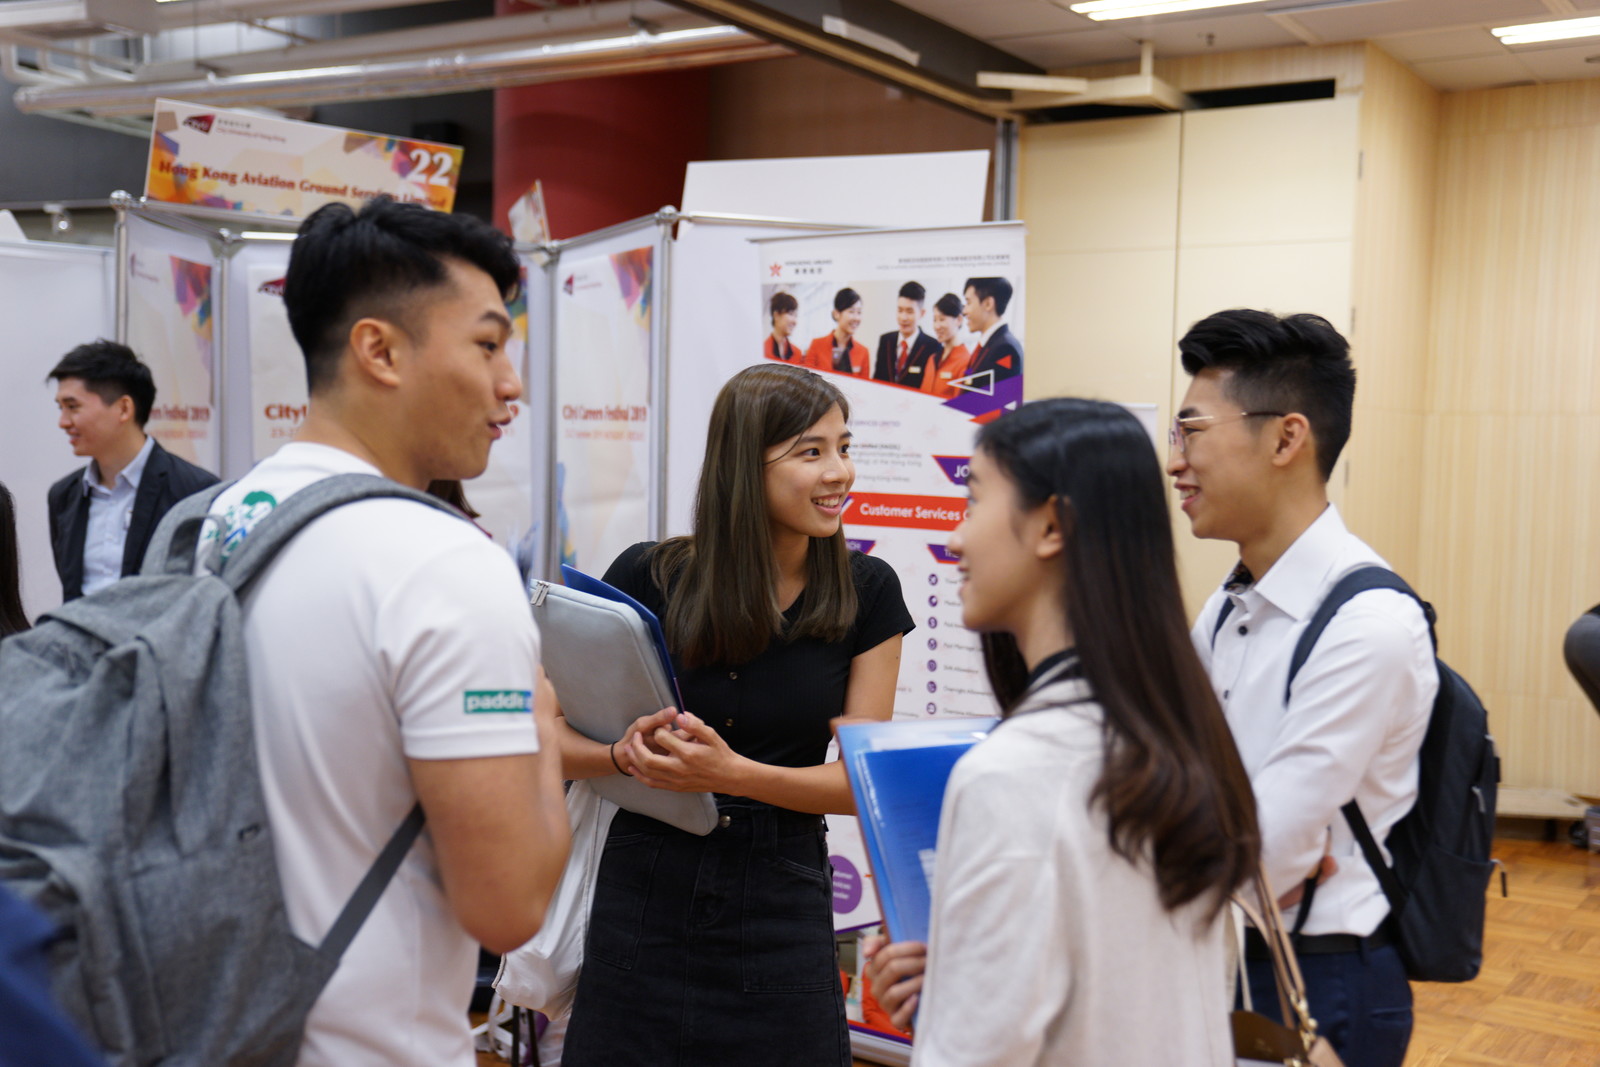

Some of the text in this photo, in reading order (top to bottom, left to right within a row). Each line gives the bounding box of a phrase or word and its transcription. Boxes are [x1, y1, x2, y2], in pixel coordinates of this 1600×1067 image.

[159, 160, 198, 180] Hong
[203, 166, 238, 187] Kong
[241, 171, 296, 189] Aviation
[299, 179, 348, 196] Ground
[406, 148, 453, 186] 22
[860, 502, 913, 518] Customer
[915, 505, 961, 521] Services
